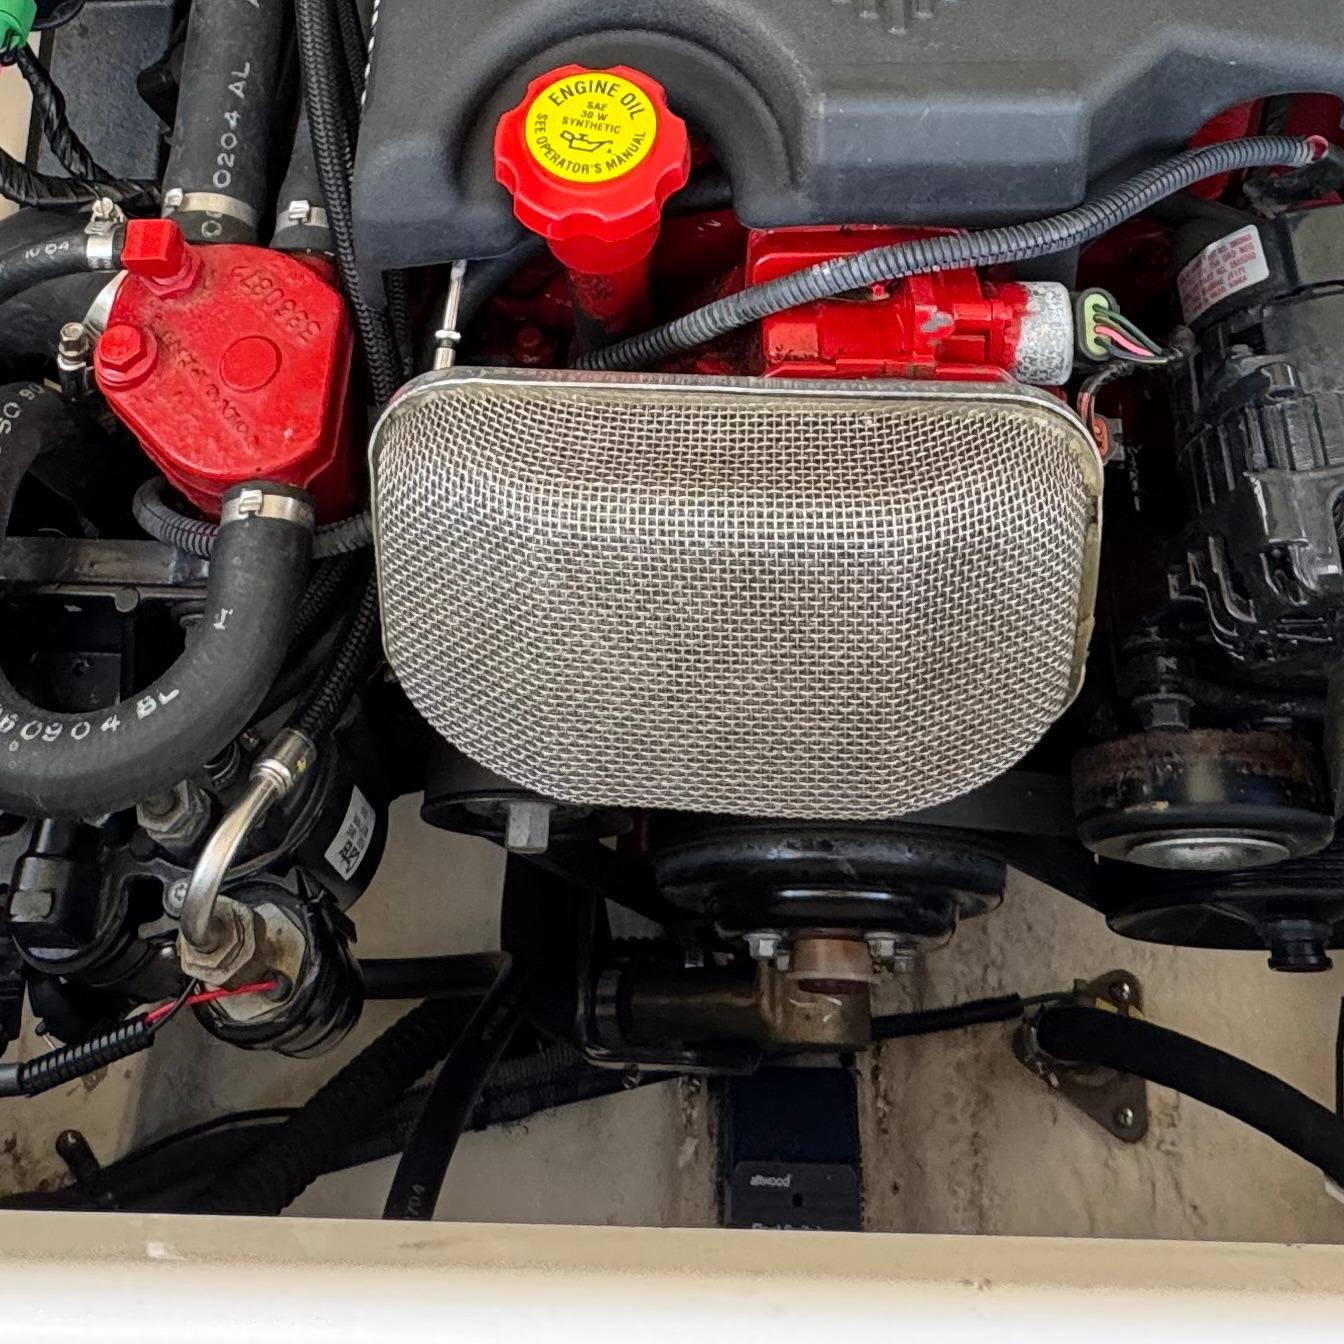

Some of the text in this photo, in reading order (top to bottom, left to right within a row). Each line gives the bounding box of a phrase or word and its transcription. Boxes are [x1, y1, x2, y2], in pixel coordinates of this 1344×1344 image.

[228, 61, 251, 99] AL
[548, 80, 645, 120] ENGINE OIL
[586, 101, 608, 110] SAE
[562, 117, 621, 134] SYNTHETIC
[581, 110, 608, 121] 30 W
[535, 113, 646, 174] SEE OPERATOR'S MANUAL
[136, 689, 180, 719] BL
